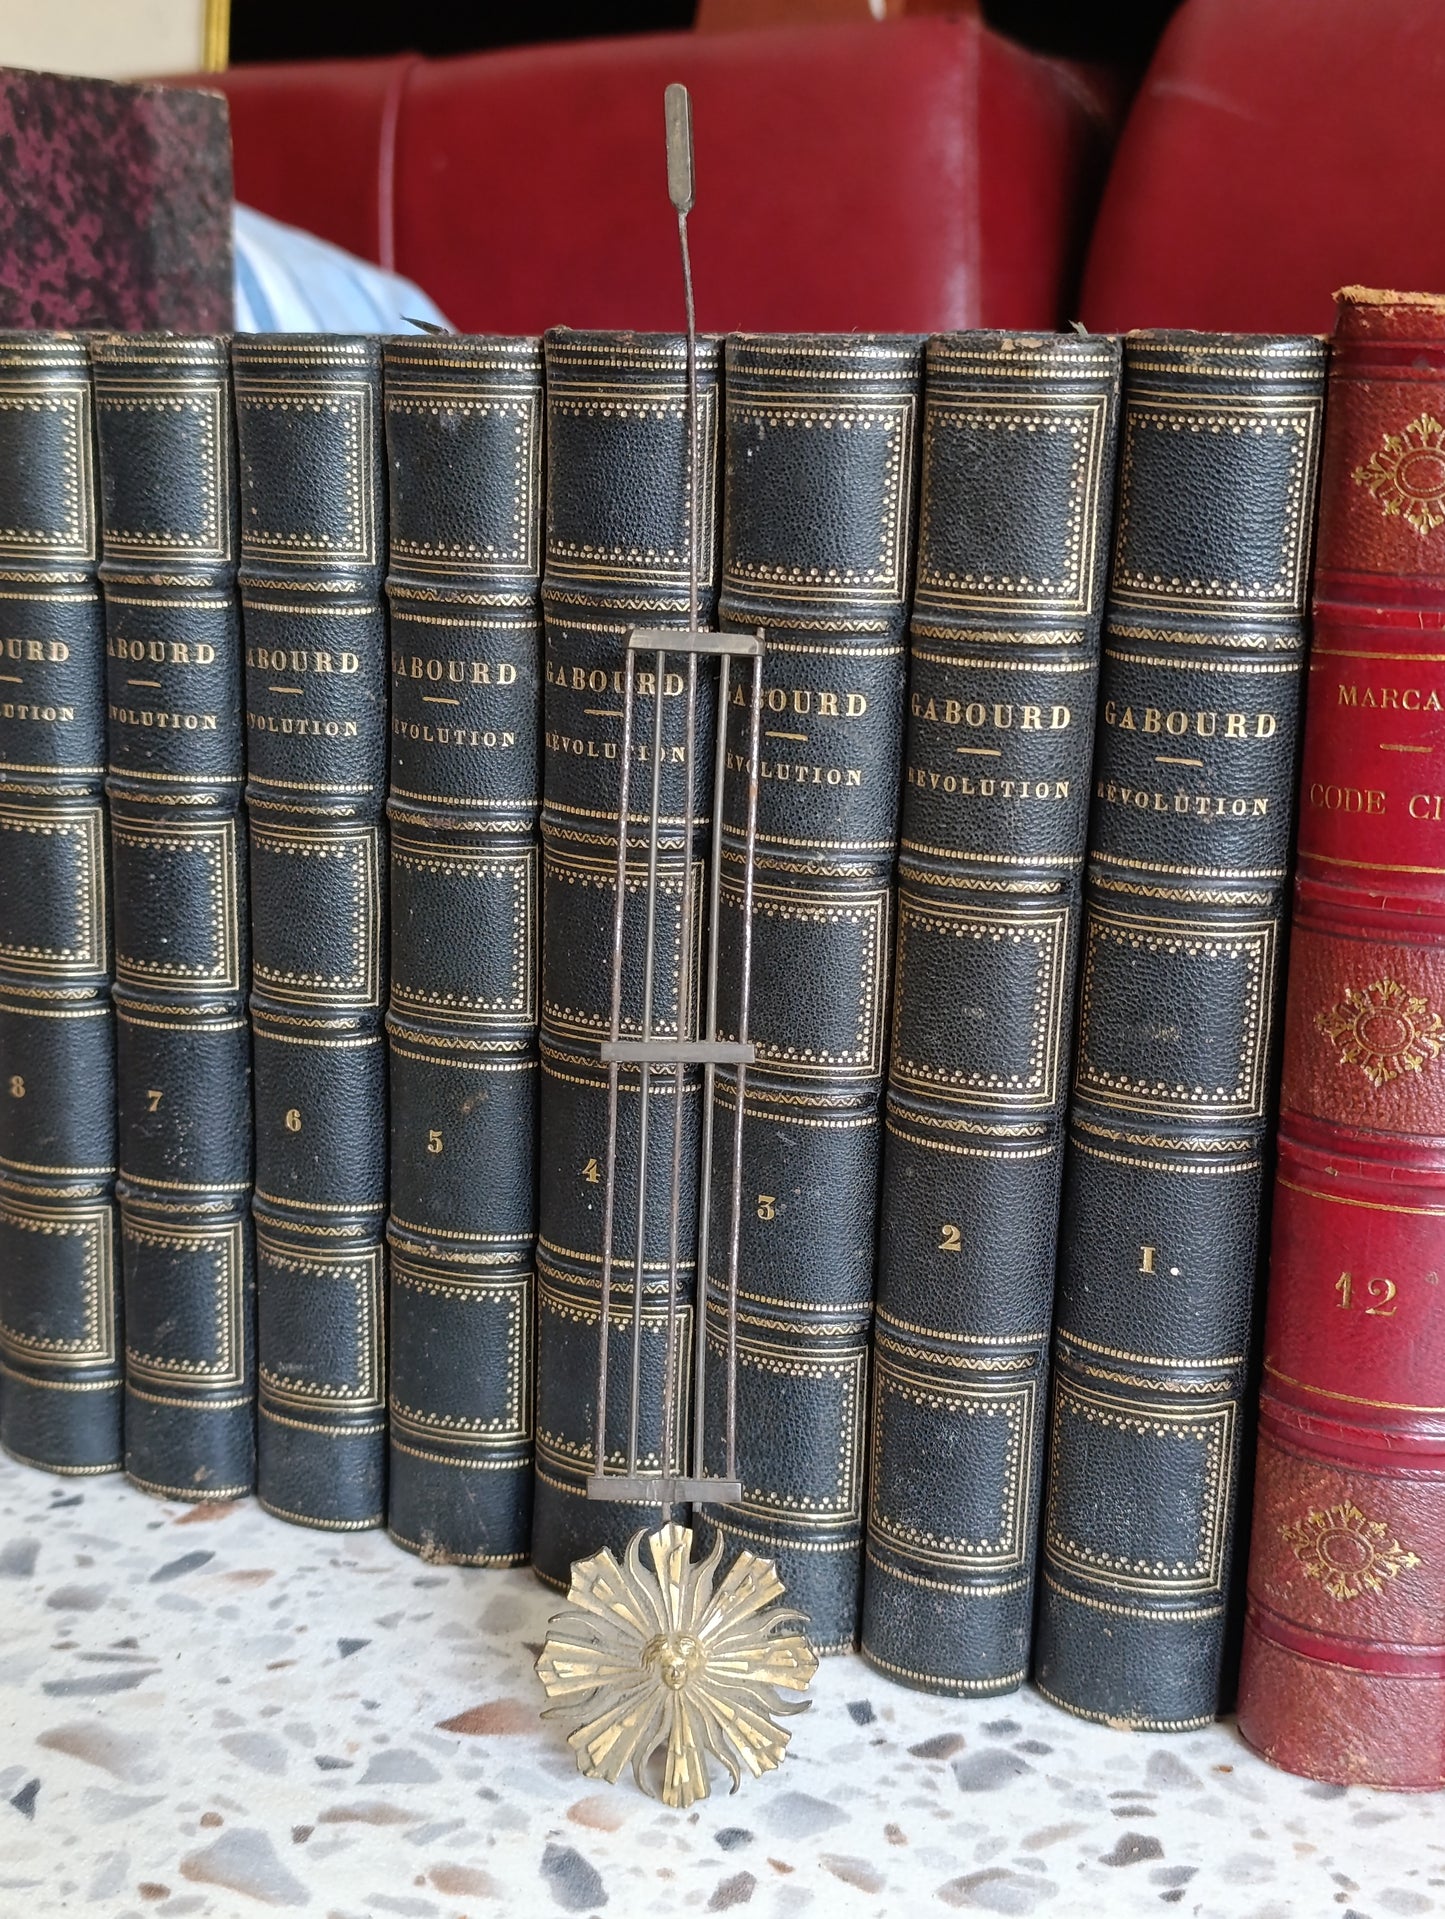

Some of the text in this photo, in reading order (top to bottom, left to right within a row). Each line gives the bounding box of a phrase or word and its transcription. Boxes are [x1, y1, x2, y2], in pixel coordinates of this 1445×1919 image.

[911, 692, 1071, 730] GABOURD
[1337, 684, 1445, 712] MARCA
[0, 703, 75, 722] UTION
[109, 704, 217, 730] VOLUTION
[247, 710, 358, 737] VOLUTION
[1105, 700, 1277, 738] GABOURD
[1310, 783, 1444, 821] CODE CI
[11, 1074, 26, 1098] 8
[147, 1089, 163, 1112] 7
[286, 1108, 302, 1131] 6
[427, 1129, 443, 1153] 5
[582, 1158, 600, 1183] 4
[757, 1195, 776, 1220] 3
[938, 1224, 962, 1252] 2
[1334, 1271, 1397, 1317] 12
